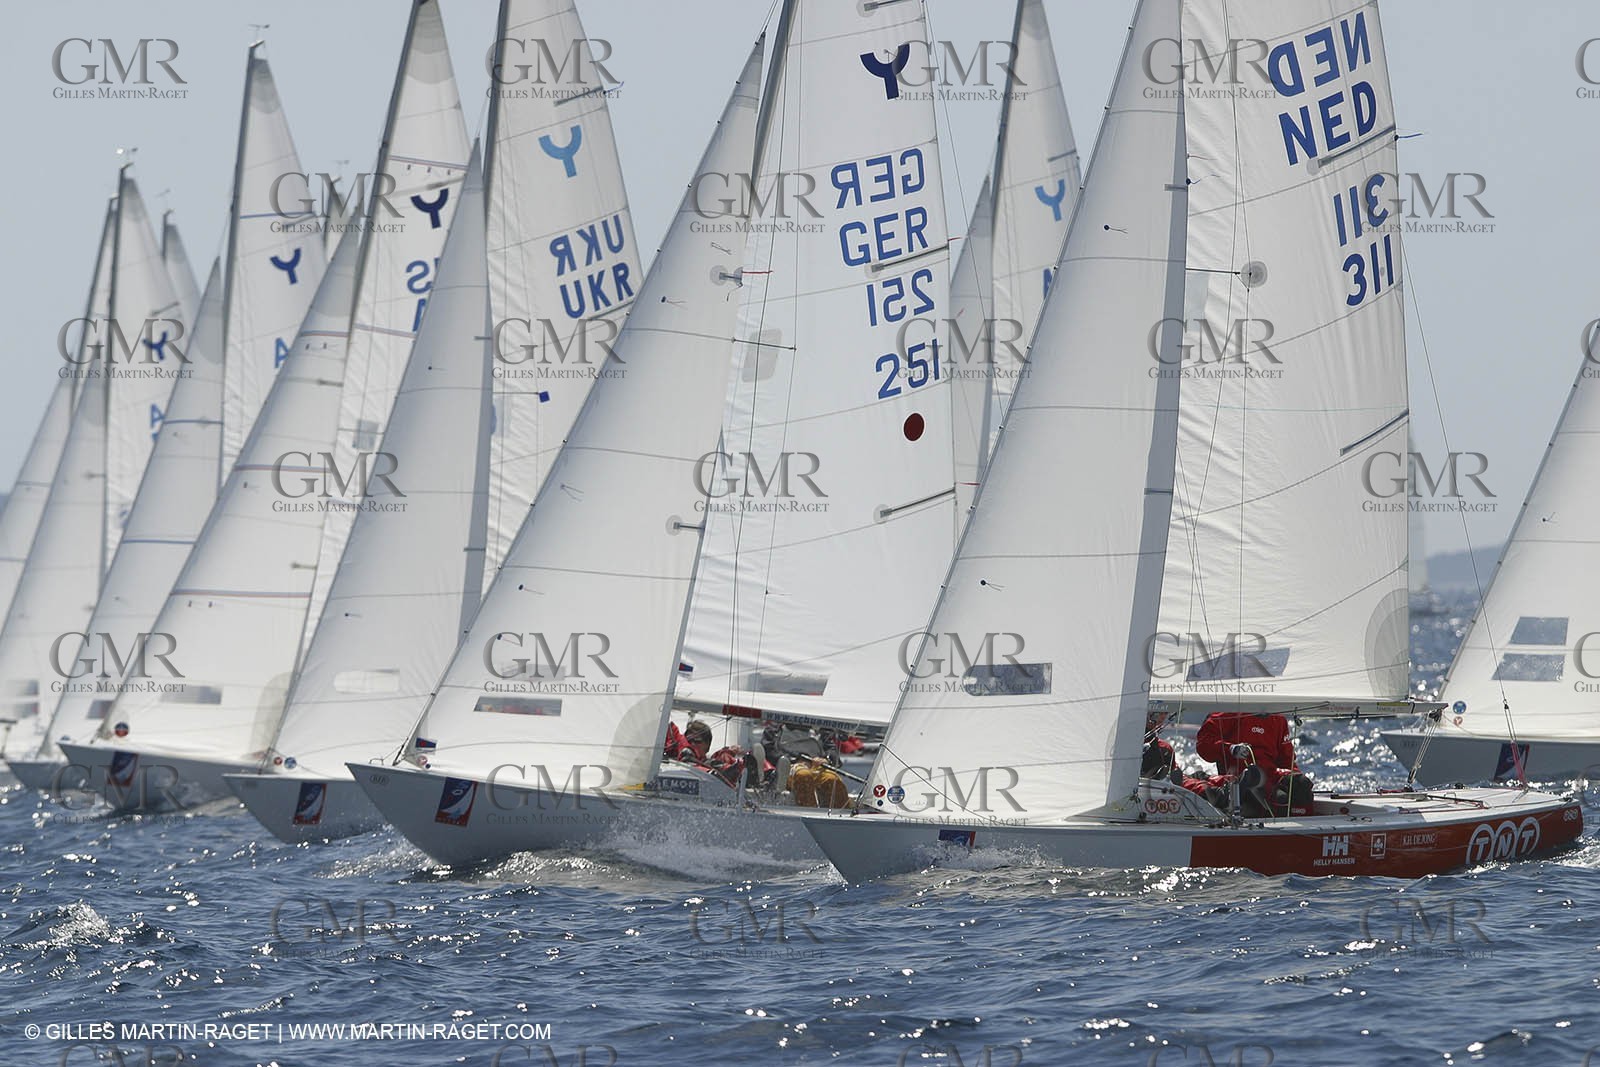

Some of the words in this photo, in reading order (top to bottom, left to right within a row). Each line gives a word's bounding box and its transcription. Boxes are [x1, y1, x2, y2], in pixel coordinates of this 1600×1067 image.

[1278, 81, 1377, 166] NED
[839, 206, 928, 267] GER
[559, 262, 635, 319] UKR
[1342, 234, 1395, 306] 311
[875, 338, 940, 400] 251
[1470, 824, 1538, 861] TNT
